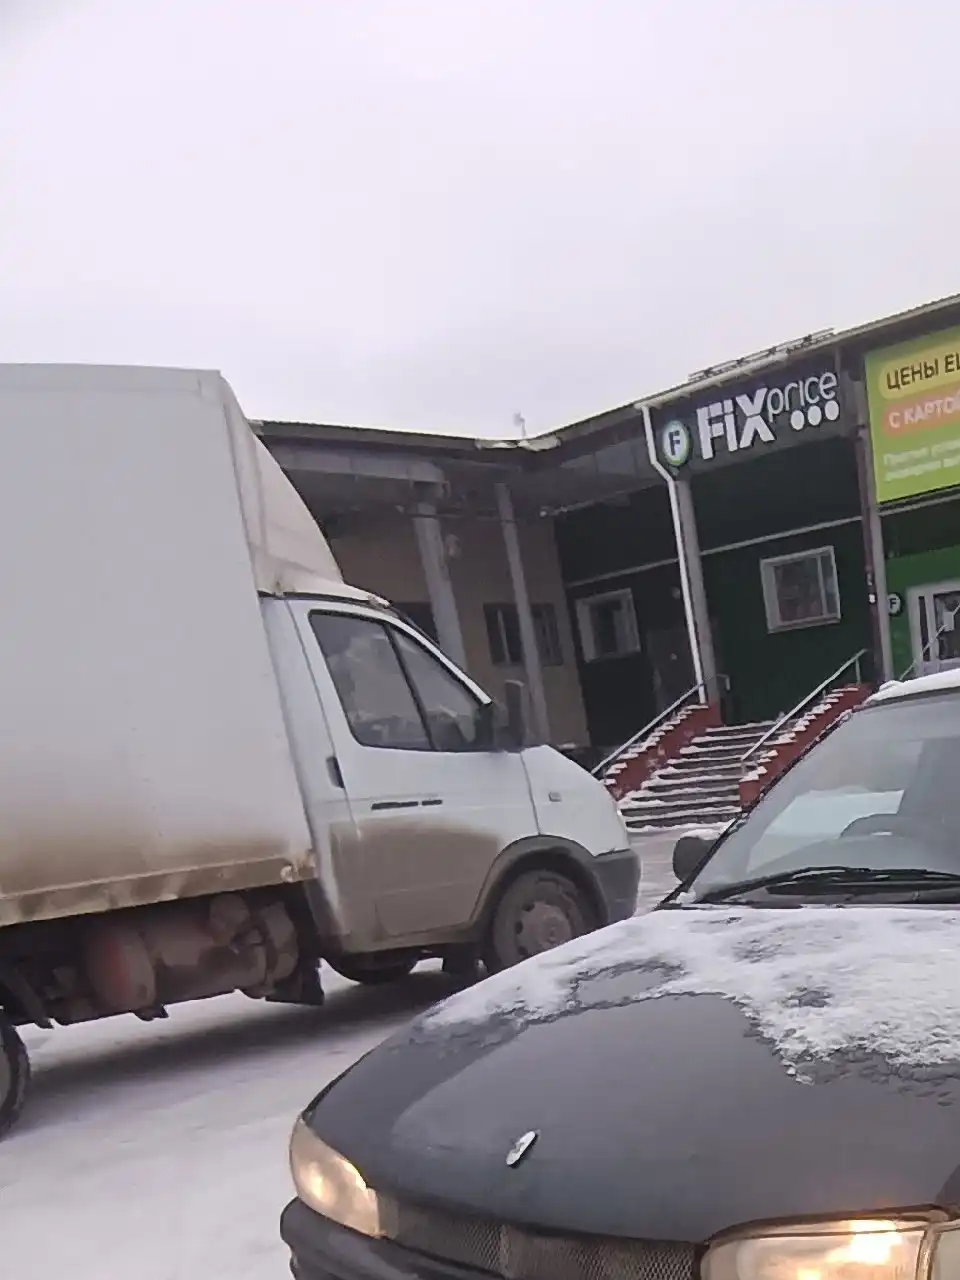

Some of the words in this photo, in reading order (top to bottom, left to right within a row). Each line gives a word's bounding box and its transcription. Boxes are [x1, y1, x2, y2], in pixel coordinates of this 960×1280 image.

[886, 358, 939, 391] ЦЕНЫ
[766, 371, 837, 422] price
[667, 430, 681, 456] F
